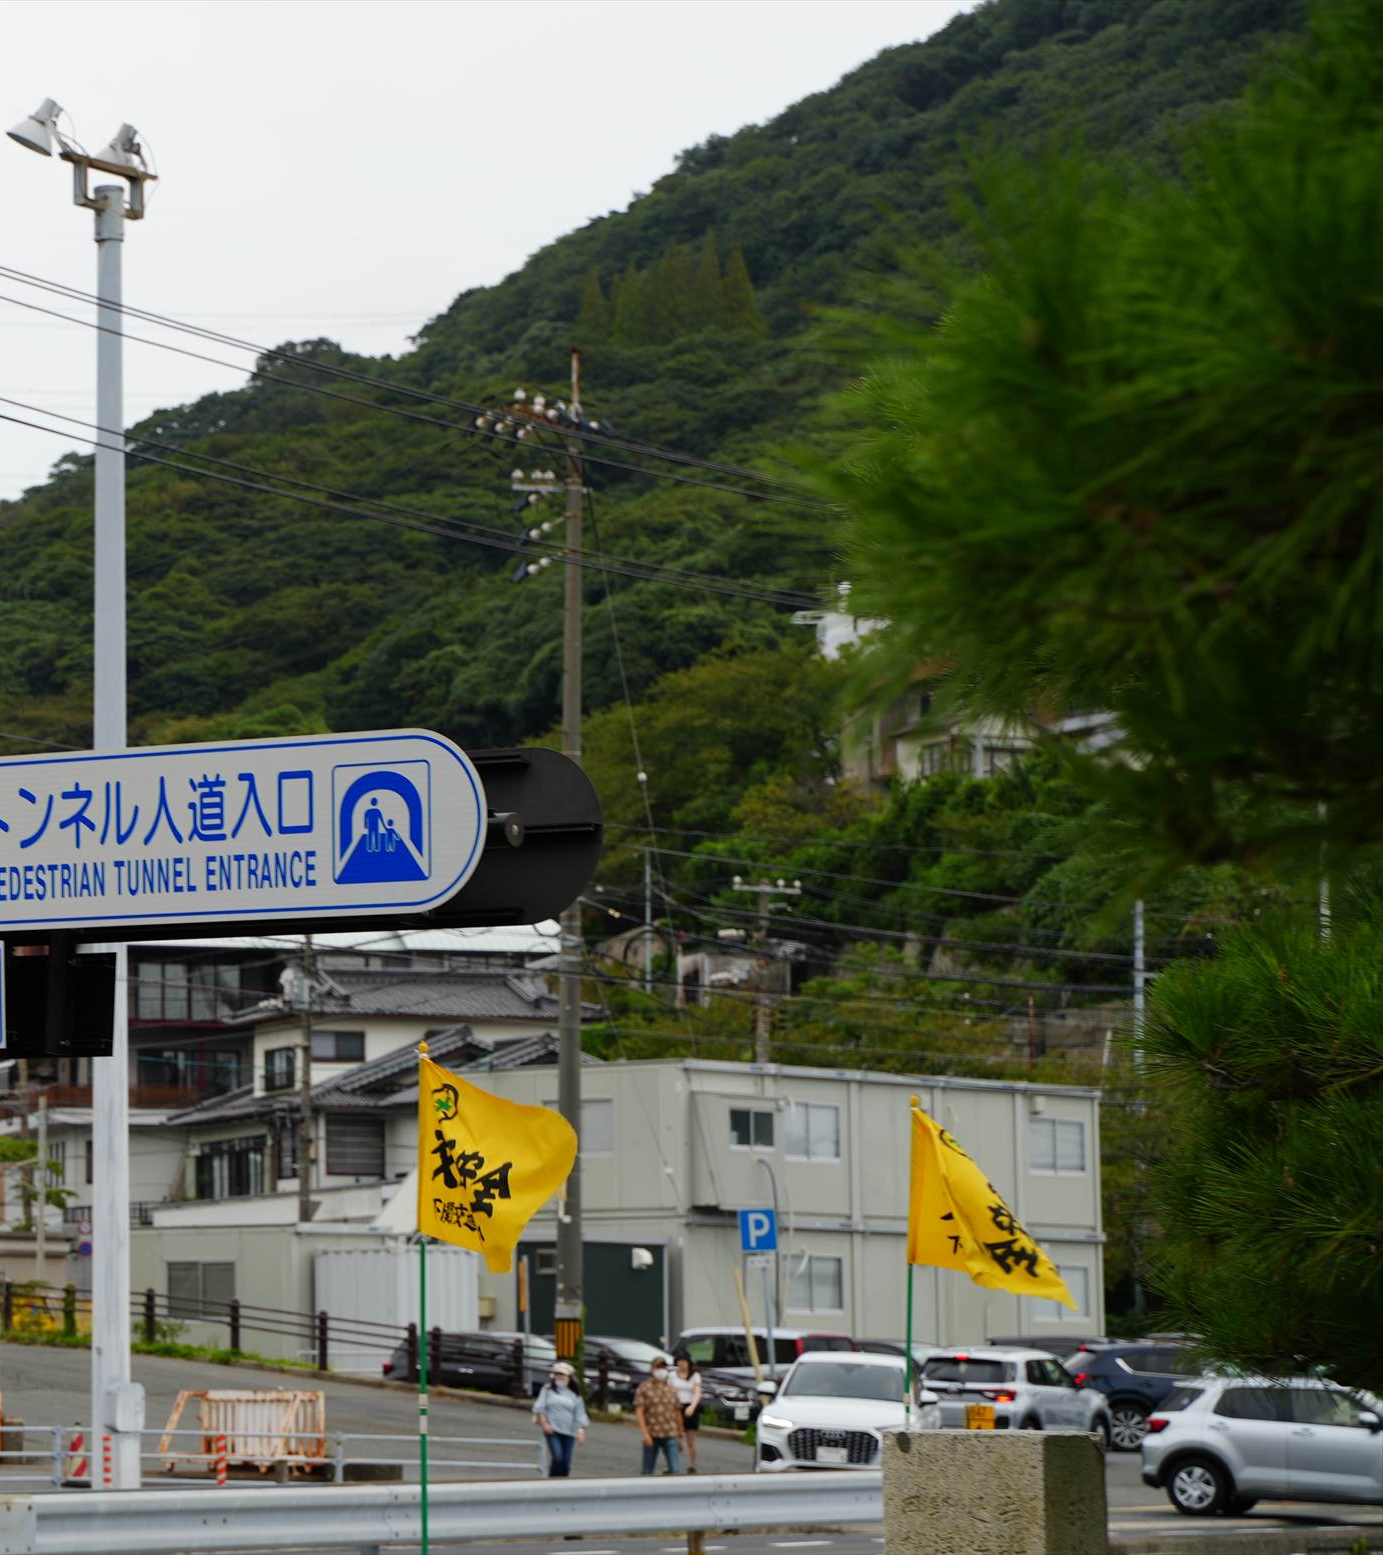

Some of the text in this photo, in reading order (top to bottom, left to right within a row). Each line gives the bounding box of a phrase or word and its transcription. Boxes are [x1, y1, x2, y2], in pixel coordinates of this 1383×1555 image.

[113, 858, 197, 896] TUNNEL
[206, 850, 317, 892] ENTRANCE
[748, 1213, 771, 1249] P
